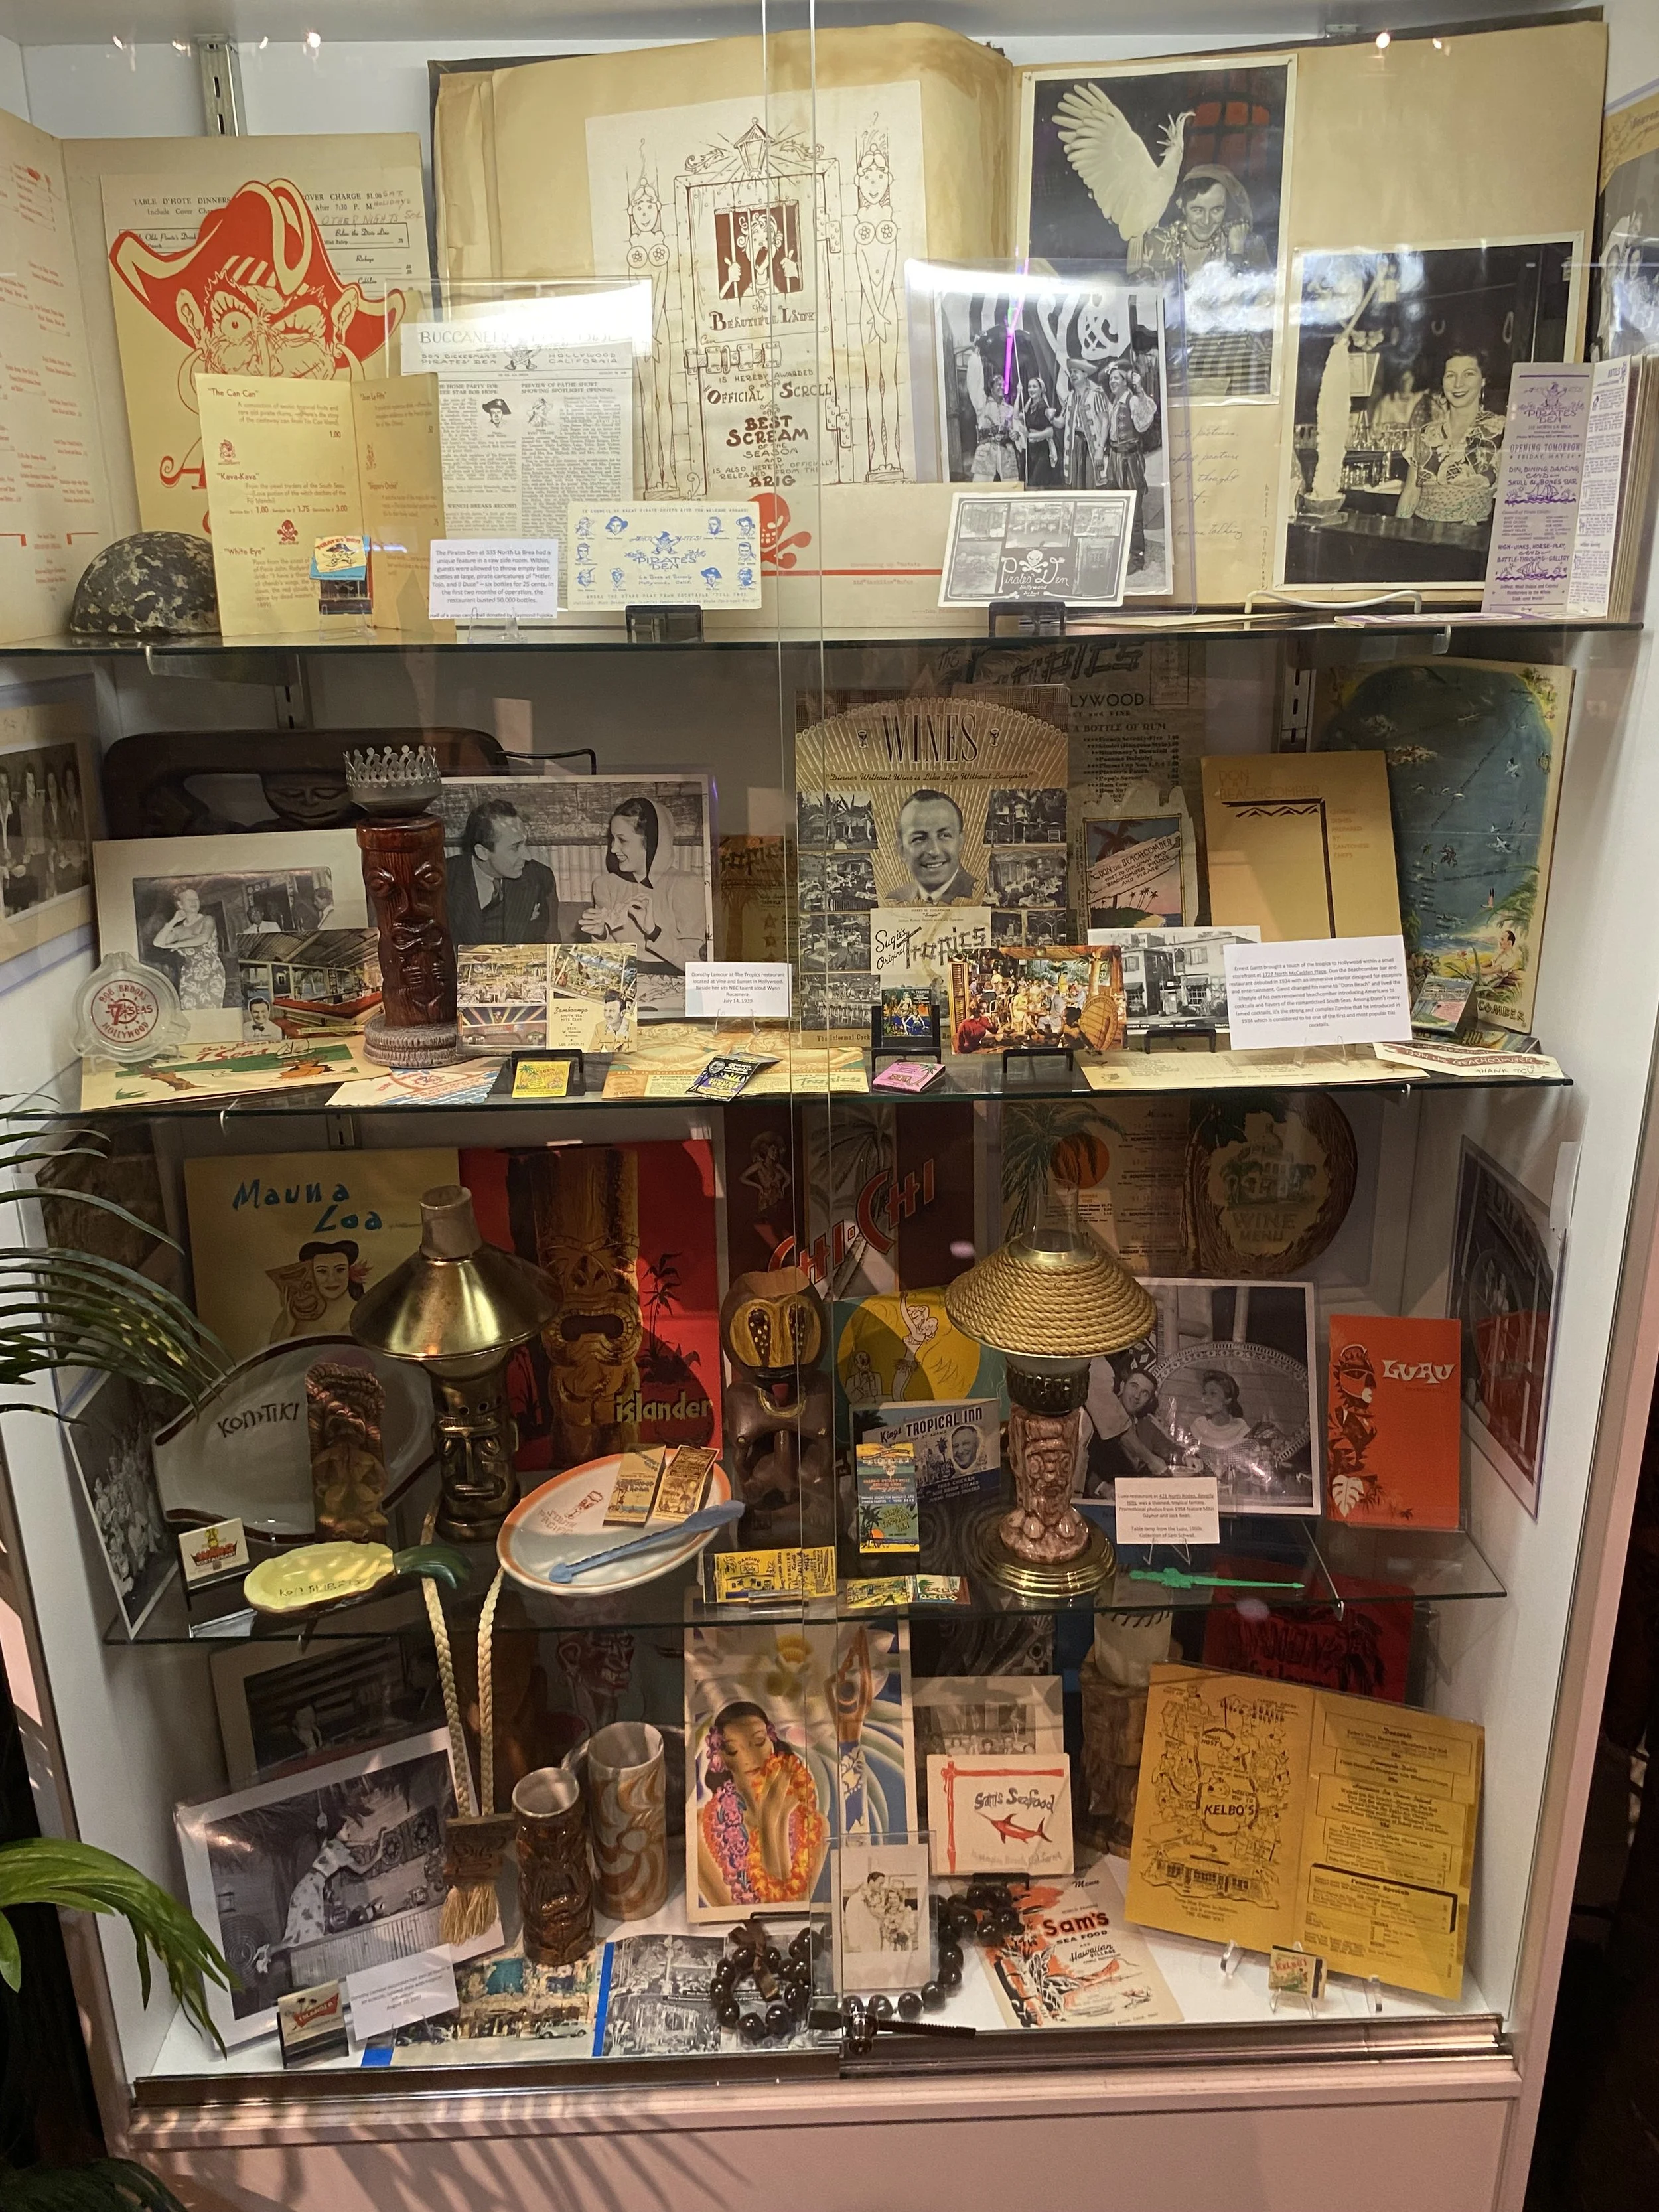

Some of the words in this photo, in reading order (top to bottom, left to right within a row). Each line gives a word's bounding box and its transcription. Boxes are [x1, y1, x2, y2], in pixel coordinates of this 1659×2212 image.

[710, 311, 779, 331] BEAUTIFUL
[745, 415, 792, 431] BEST
[726, 428, 809, 447] SCREAM
[744, 448, 798, 458] SEASON
[749, 475, 796, 487] BRIG
[1035, 557, 1069, 587] Den
[1070, 694, 1144, 707] LYWOOD
[882, 714, 978, 764] WINES
[860, 773, 891, 781] Without
[894, 773, 913, 781] Wine
[923, 773, 940, 781] Like
[943, 773, 958, 782] Life
[961, 773, 990, 781] Without
[993, 772, 1033, 782] Laughter"
[1098, 866, 1113, 877] DON
[1121, 838, 1172, 867] BEACHCOMBER
[1107, 867, 1145, 887] BEACHCOMBER
[1121, 877, 1133, 886] AND
[1137, 866, 1159, 878] PIRATE
[875, 928, 906, 952] Sugie's
[877, 945, 906, 970] Original
[100, 988, 115, 1003] BOB
[119, 984, 147, 1000] BROOKS
[108, 1003, 123, 1025] 7
[129, 1005, 153, 1014] SEAS
[102, 1021, 149, 1039] HOLLYWOOD
[1405, 1049, 1428, 1059] DON
[1452, 1056, 1538, 1066] BEACHCOMBER
[232, 1179, 350, 1211] Mauna
[856, 1158, 934, 1254] CHI
[313, 1205, 382, 1233] Loa
[1382, 1359, 1456, 1384] LUAU
[614, 1390, 713, 1423] islander
[880, 1428, 902, 1443] Kings
[906, 1414, 960, 1436] TROPICAL
[964, 1407, 983, 1423] INN
[974, 1792, 1003, 1810] Sam's
[1006, 1787, 1055, 1813] Seafood
[1204, 1804, 1256, 1817] KELBO'S
[1072, 1880, 1099, 1888] Menu
[1043, 1911, 1109, 1936] Sam's
[1081, 1930, 1108, 1939] FOOD
[1070, 1943, 1113, 1962] Hawaiian
